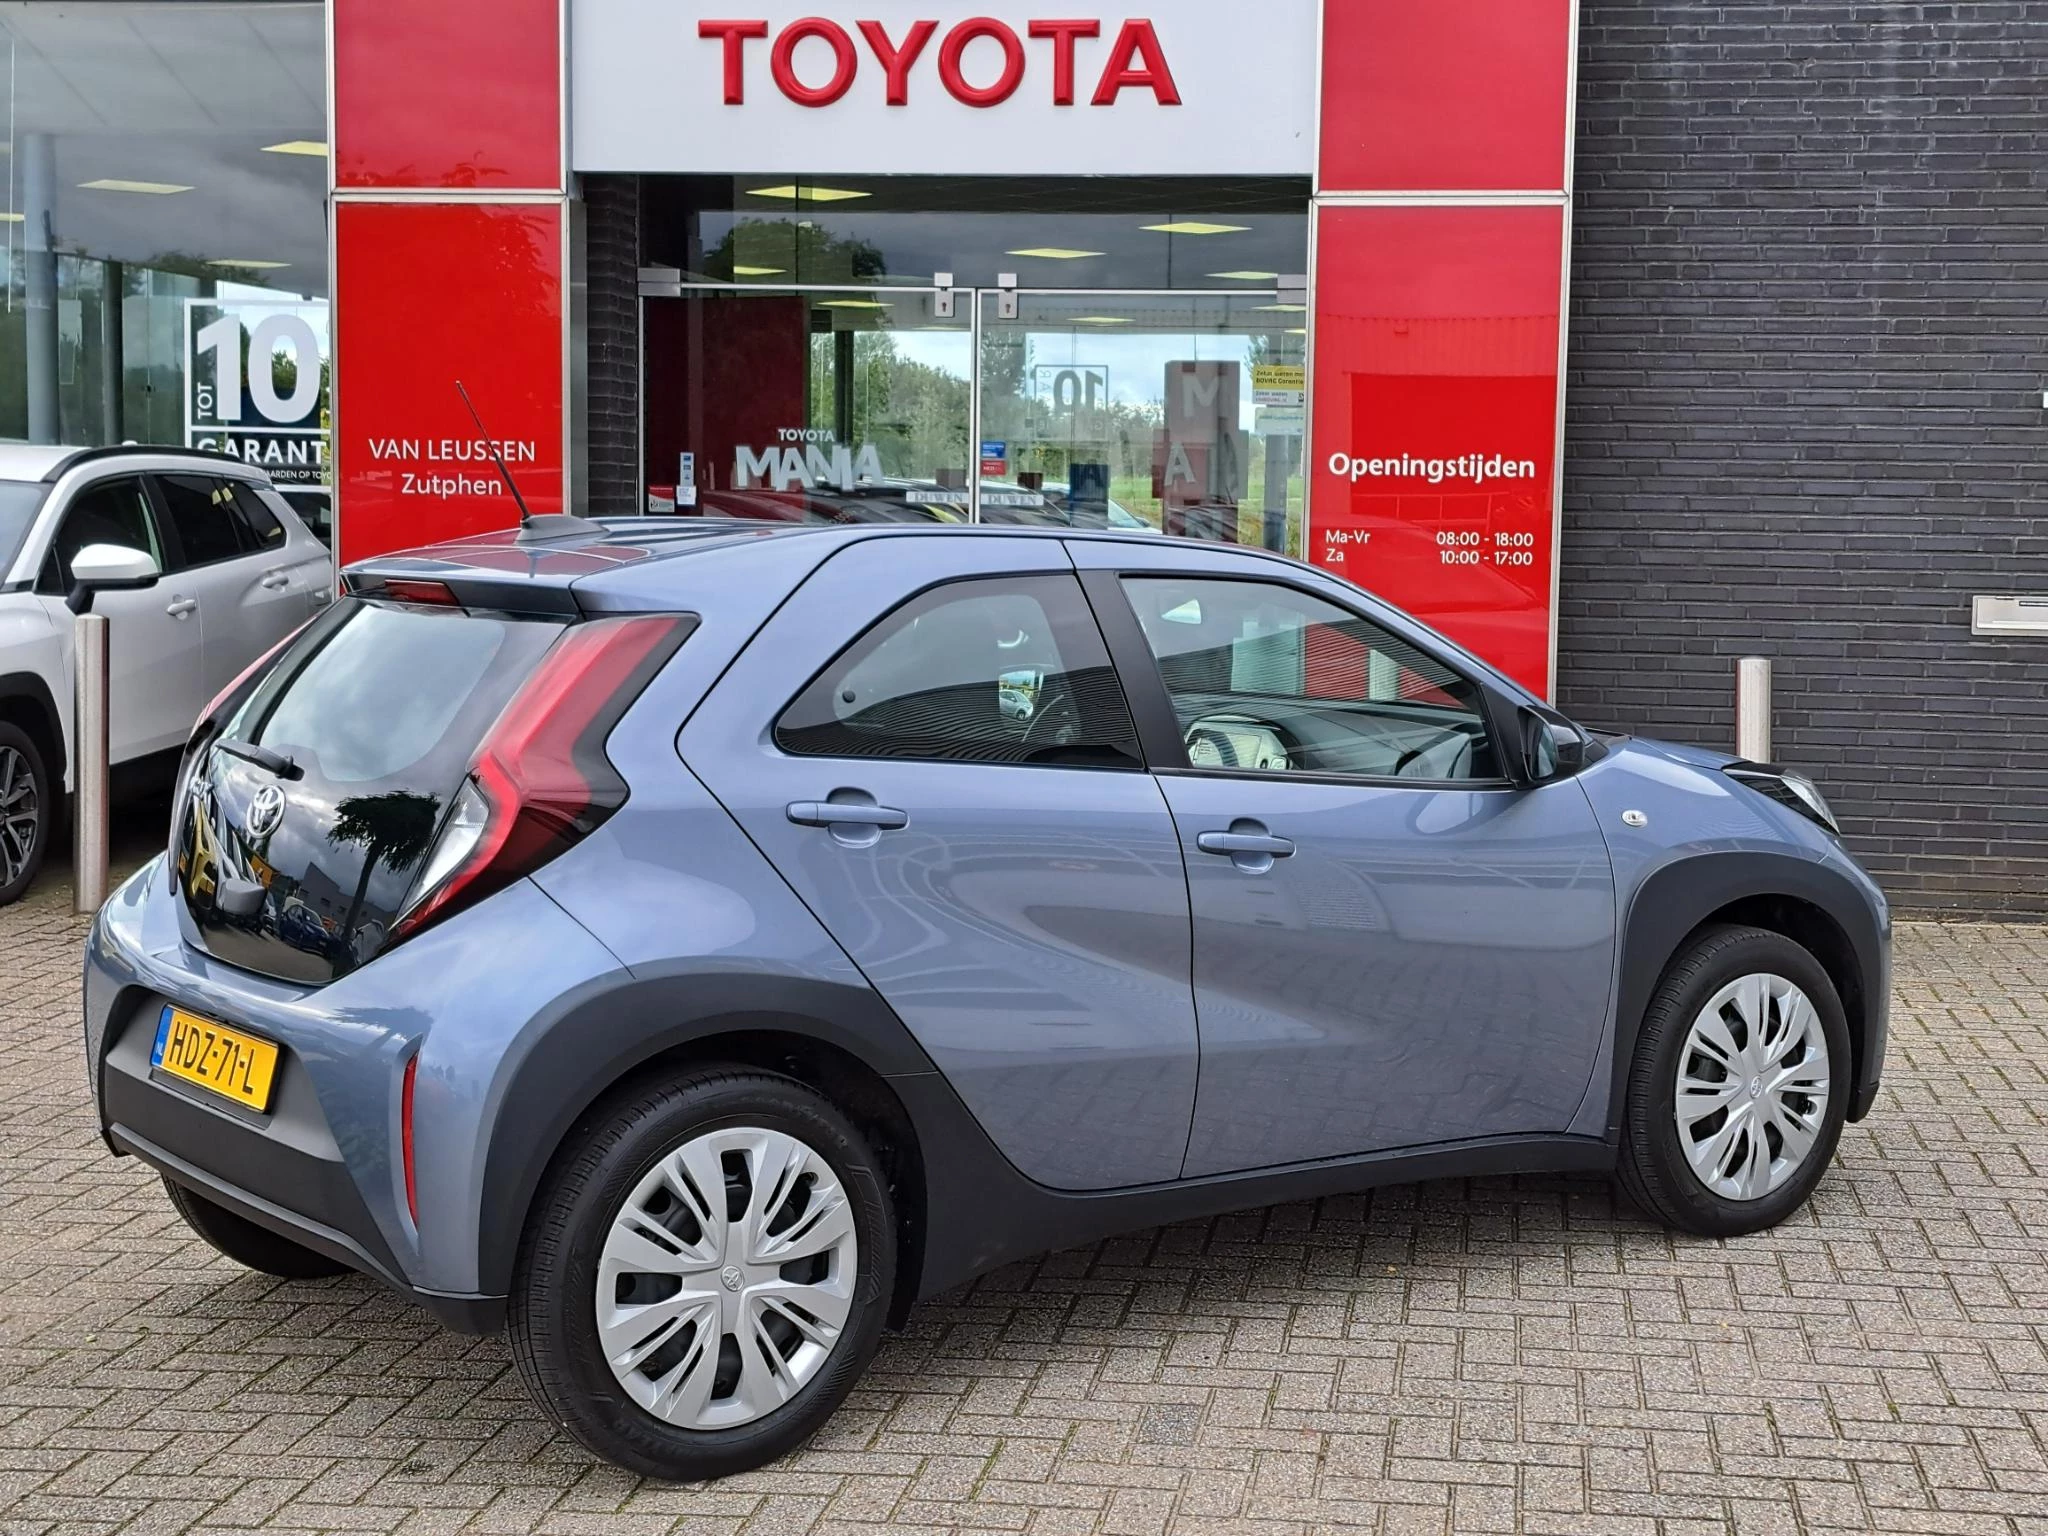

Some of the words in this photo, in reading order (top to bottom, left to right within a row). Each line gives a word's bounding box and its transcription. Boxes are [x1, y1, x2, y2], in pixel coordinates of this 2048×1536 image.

[697, 17, 1183, 108] TOYOTA
[197, 313, 321, 424] 10
[197, 382, 213, 419] TOT
[778, 428, 836, 442] TOYOTA
[368, 439, 420, 460] VAN
[428, 439, 535, 462] LEUSSEN
[298, 471, 311, 479] OP
[735, 443, 883, 492] MANIA
[1328, 452, 1536, 483] Openingstijden
[401, 473, 502, 500] Zutphen
[1325, 530, 1370, 545] Ma-Vr
[1436, 531, 1480, 546] 08:00
[1495, 532, 1534, 547] 18:00
[1325, 549, 1344, 562] Za
[1440, 550, 1480, 565] 10:00
[1494, 551, 1533, 566] 17:00
[168, 1020, 255, 1095] HDZ-71-L
